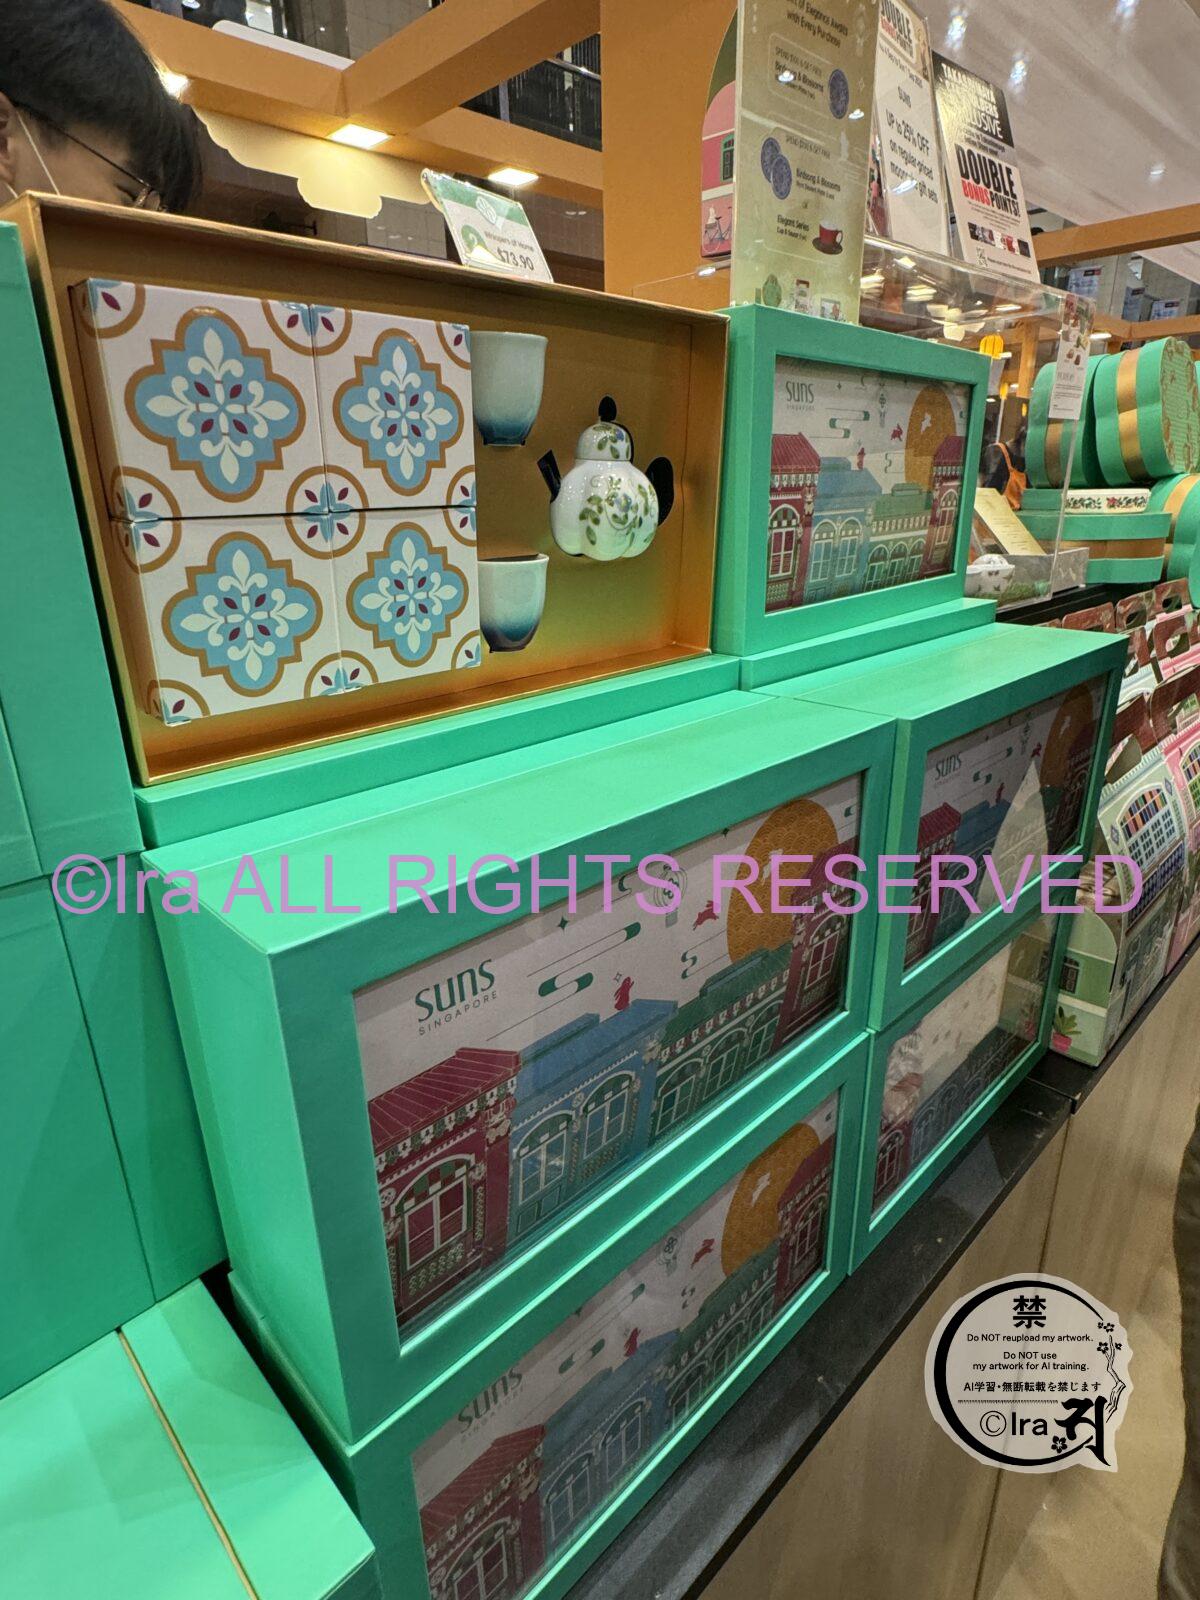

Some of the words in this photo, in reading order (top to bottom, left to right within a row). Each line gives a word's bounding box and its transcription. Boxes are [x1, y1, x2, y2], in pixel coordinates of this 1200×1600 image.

[800, 16, 816, 36] Every
[817, 25, 841, 48] Purchase
[886, 108, 895, 128] UP
[917, 132, 930, 156] OFF
[954, 143, 1018, 200] DOUBLE
[961, 179, 990, 206] BONUS
[989, 191, 1021, 217] POINTS!
[777, 214, 795, 229] Elegant
[796, 221, 809, 232] Series
[497, 246, 535, 271] $73.90
[418, 990, 498, 1036] SINGAPORE
